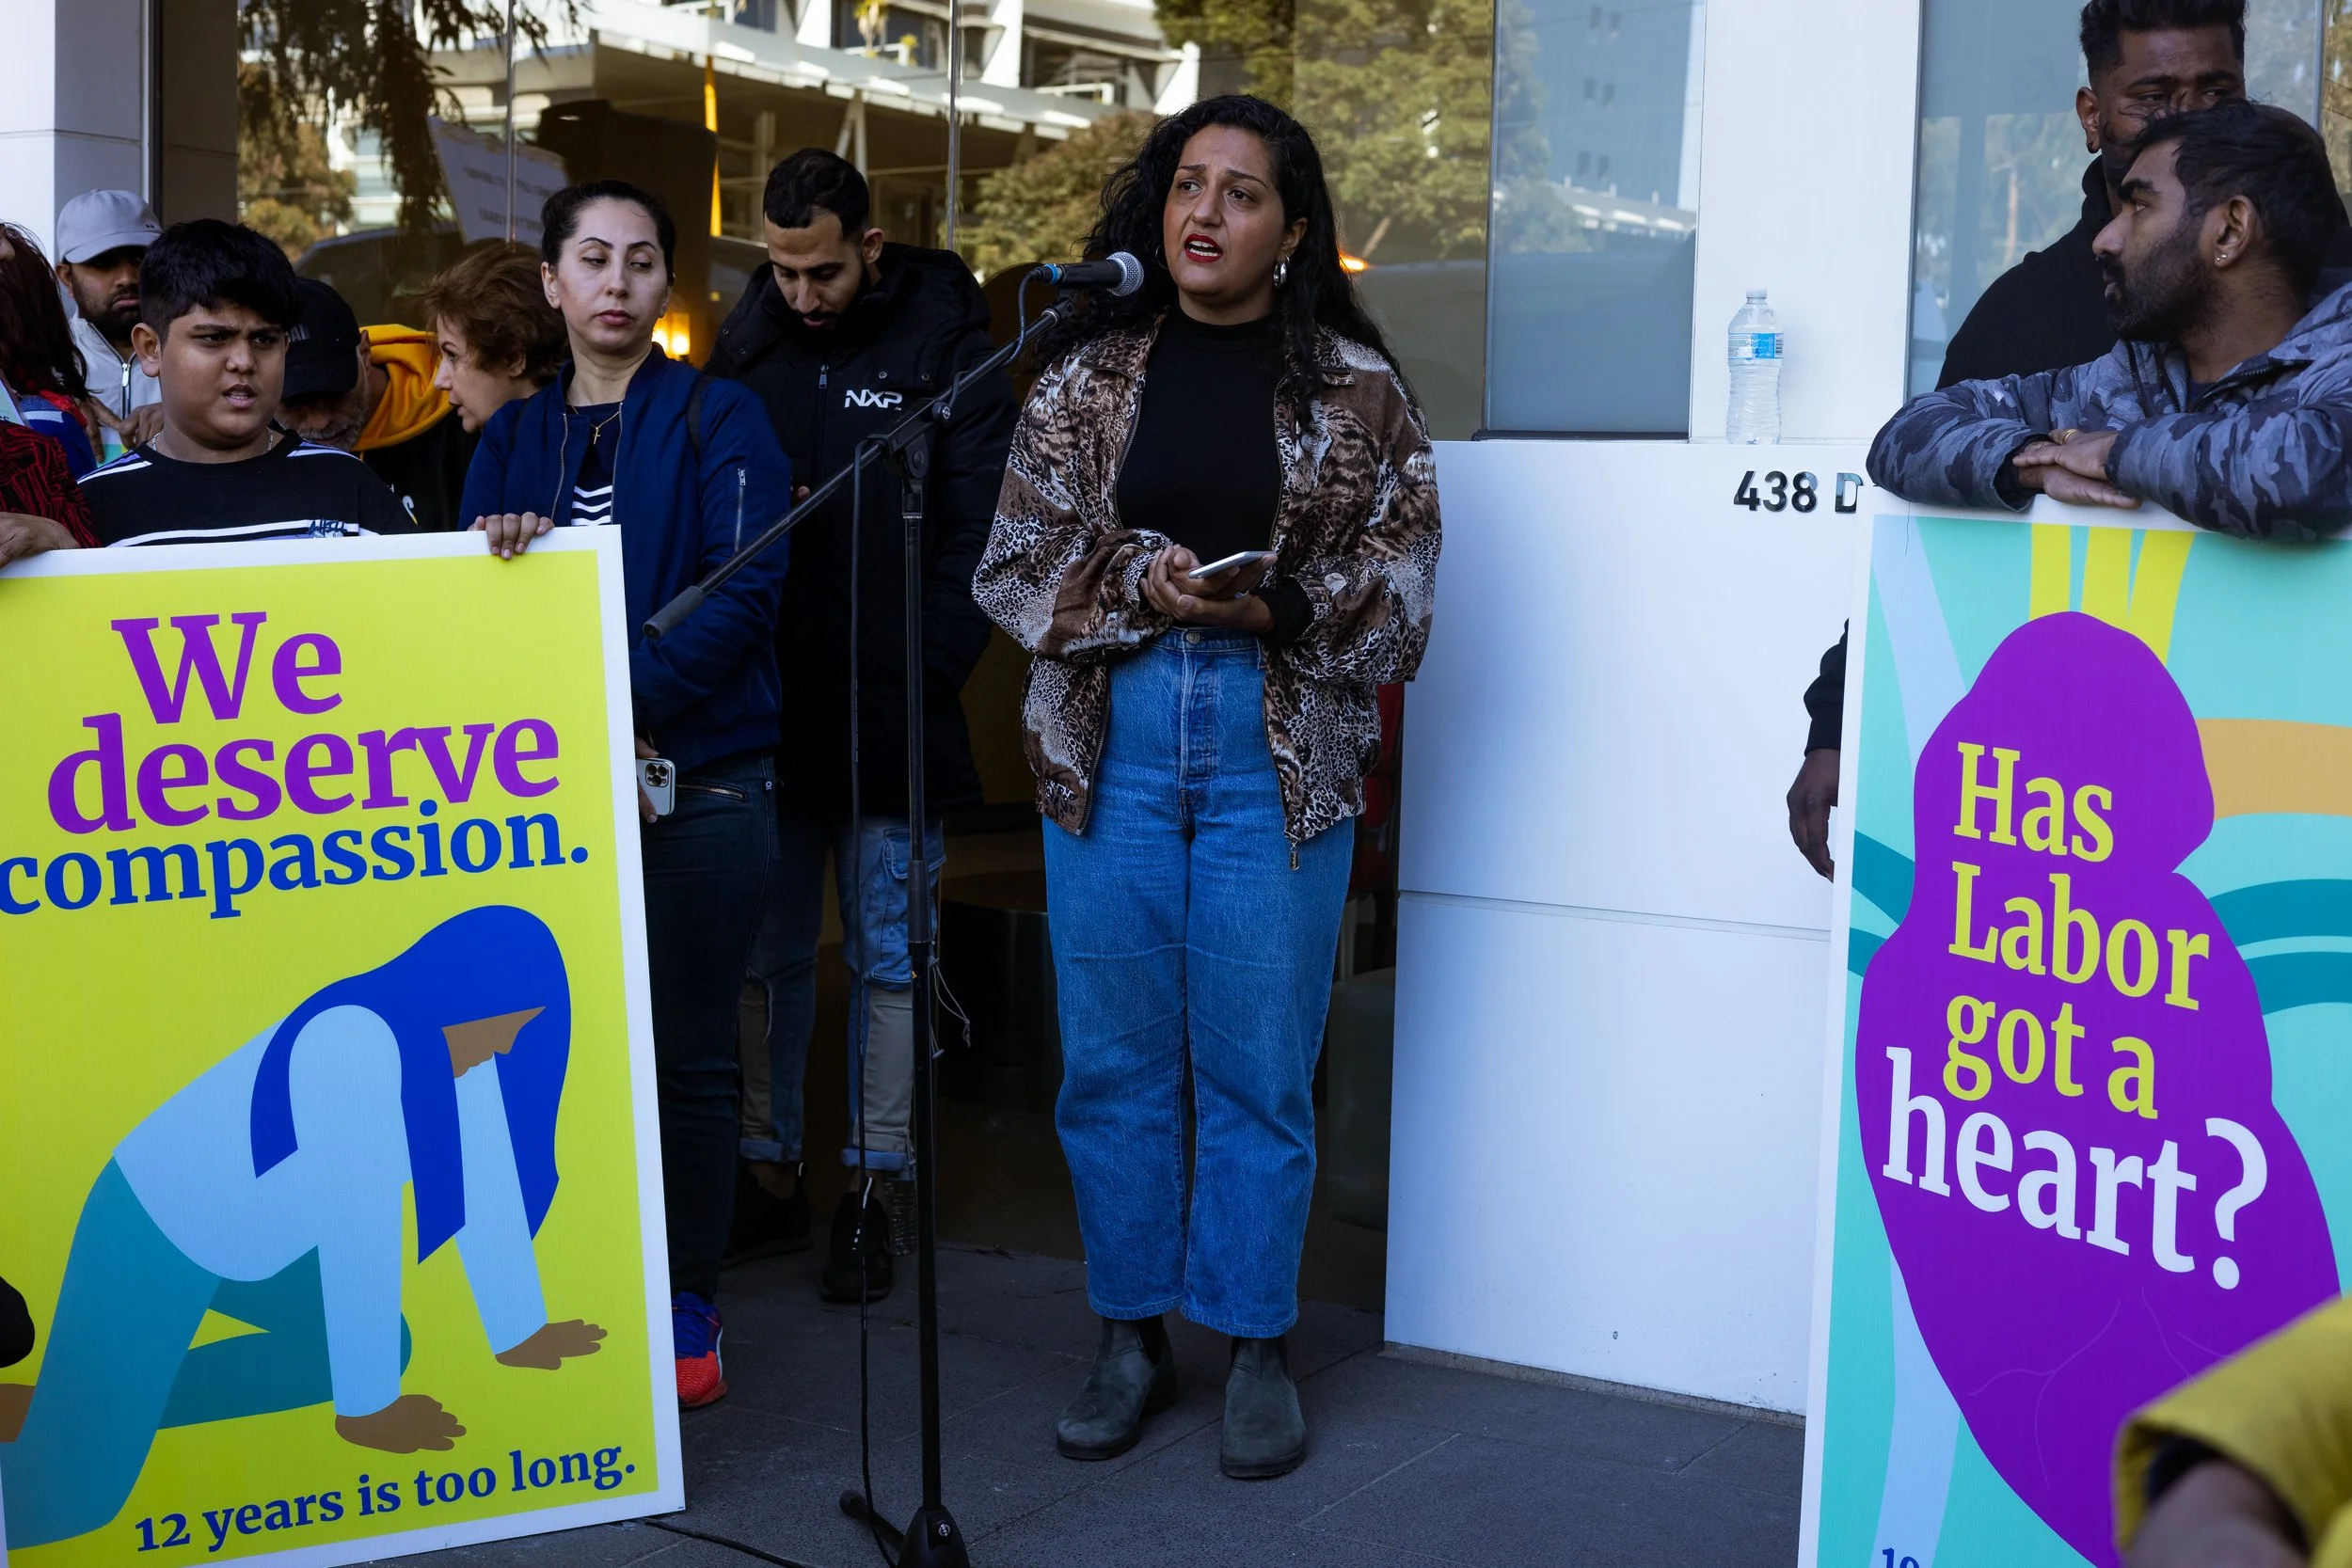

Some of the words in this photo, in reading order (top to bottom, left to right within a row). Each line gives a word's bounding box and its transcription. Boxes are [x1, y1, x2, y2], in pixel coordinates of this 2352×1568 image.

[845, 389, 902, 408] NXP
[1734, 470, 1818, 513] 438
[111, 611, 342, 724] We
[48, 712, 560, 834] deserve
[1953, 742, 2114, 863] Has
[0, 799, 590, 920] compassion.
[1948, 861, 2210, 1011] Labor
[1943, 994, 2086, 1101] got
[2107, 1037, 2159, 1119] a
[1883, 1046, 2268, 1291] heart?
[135, 1513, 191, 1552] 12
[201, 1491, 344, 1553] years
[358, 1473, 402, 1516] is
[414, 1467, 497, 1507] too
[509, 1446, 636, 1492] long.
